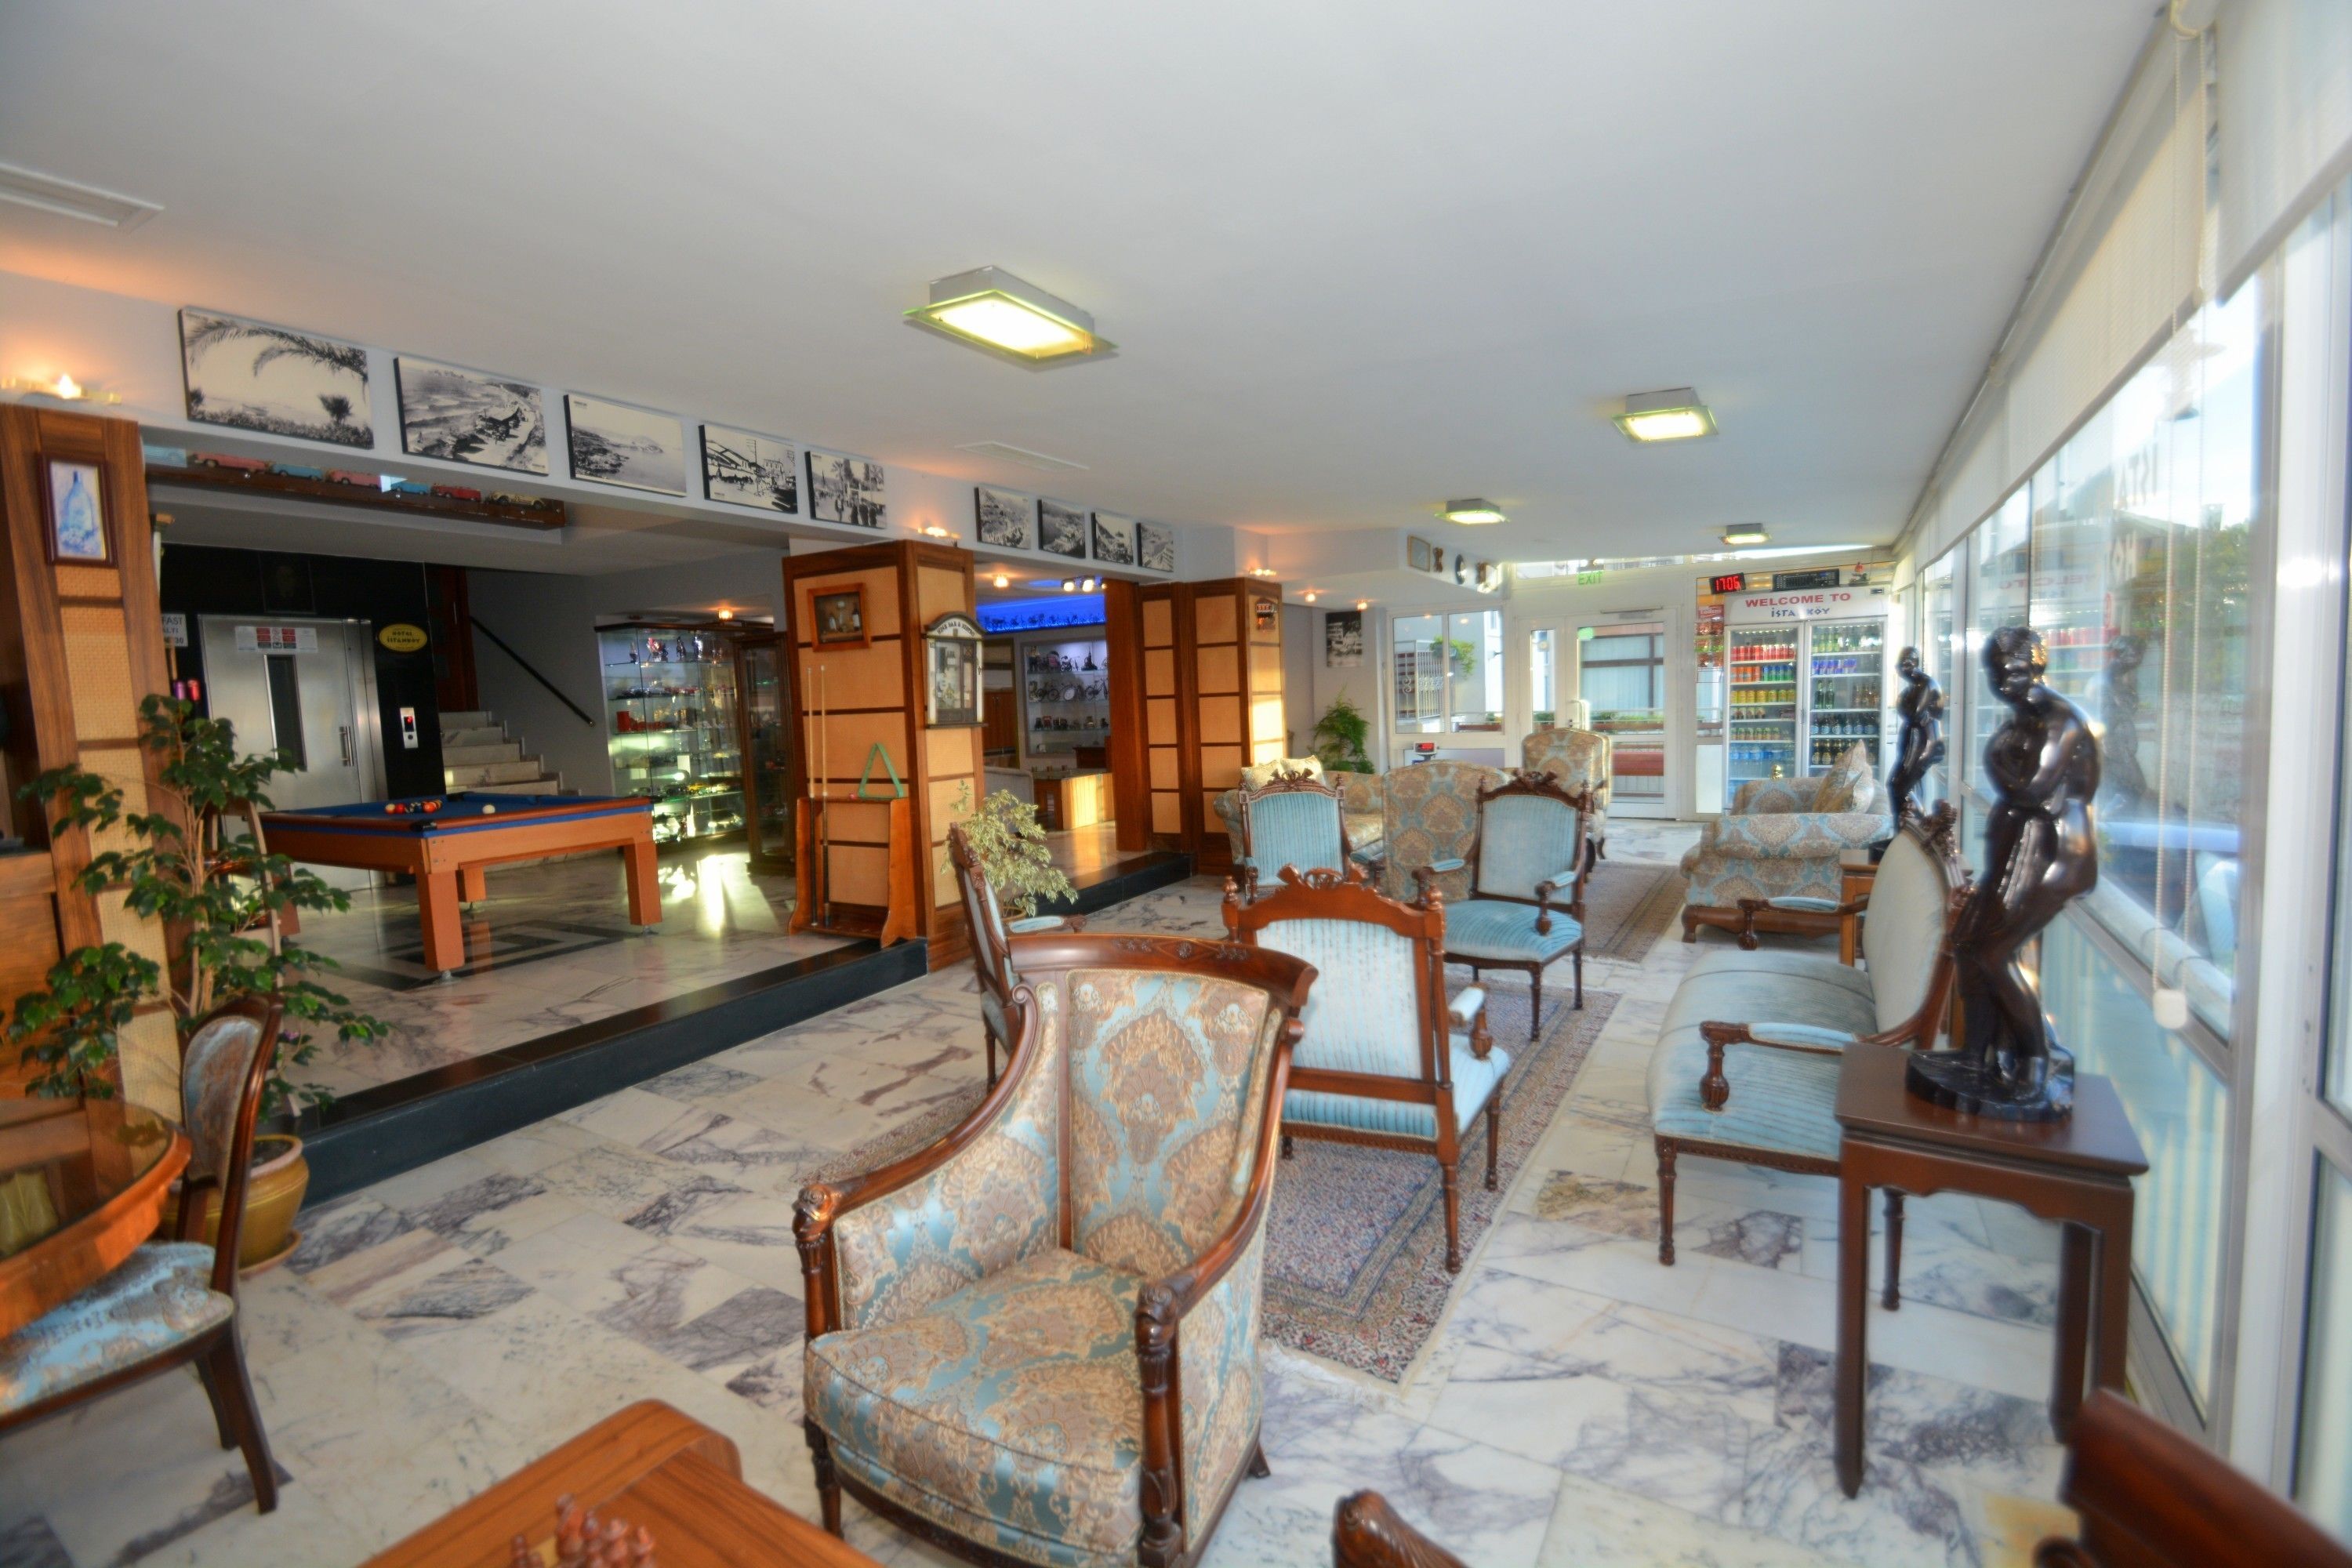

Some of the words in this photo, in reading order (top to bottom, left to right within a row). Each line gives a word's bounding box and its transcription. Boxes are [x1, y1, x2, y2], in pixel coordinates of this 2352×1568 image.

[1578, 572, 1602, 585] EXIT
[1745, 594, 1824, 608] WELCOME
[1829, 593, 1851, 602] TO
